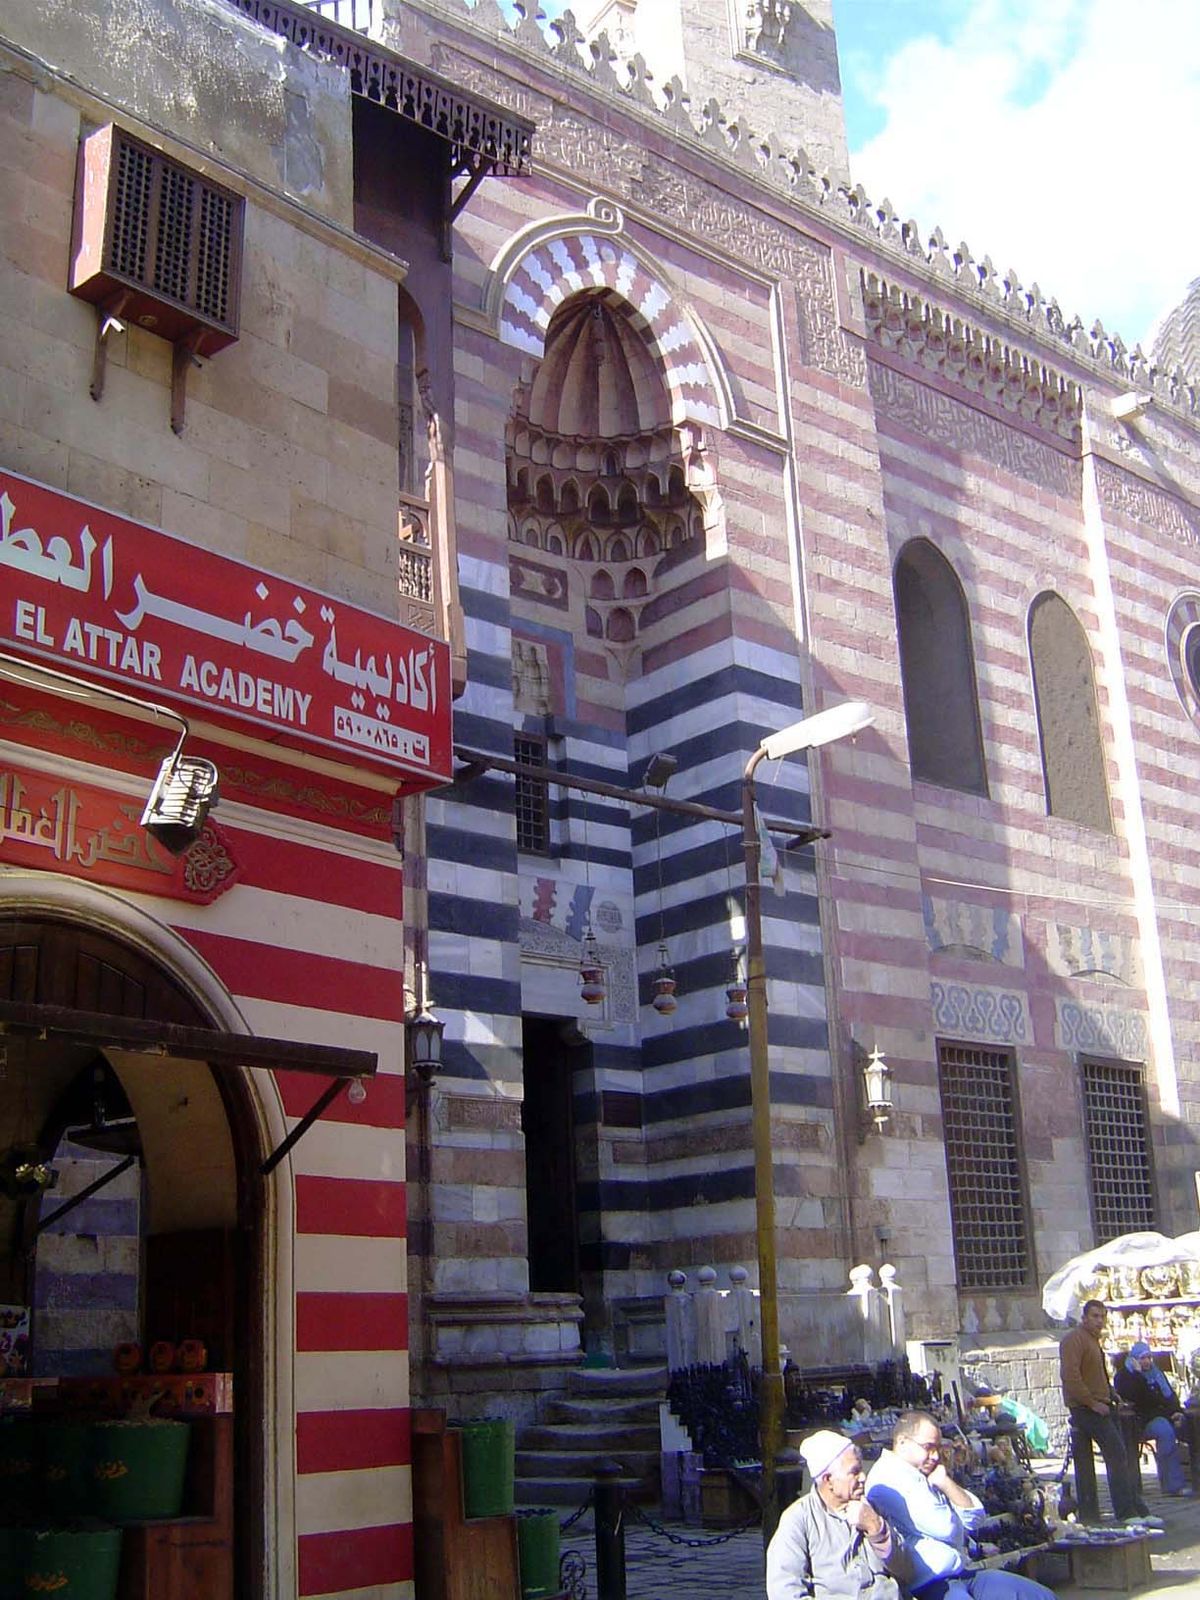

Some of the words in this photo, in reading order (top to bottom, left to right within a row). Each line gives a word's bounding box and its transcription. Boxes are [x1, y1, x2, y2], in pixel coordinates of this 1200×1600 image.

[0, 491, 114, 601] العط
[15, 599, 54, 646] EL
[63, 617, 162, 680] ATTAR
[180, 654, 312, 725] ACADEMY
[114, 573, 314, 663] خضر
[320, 604, 437, 721] أكاديمية
